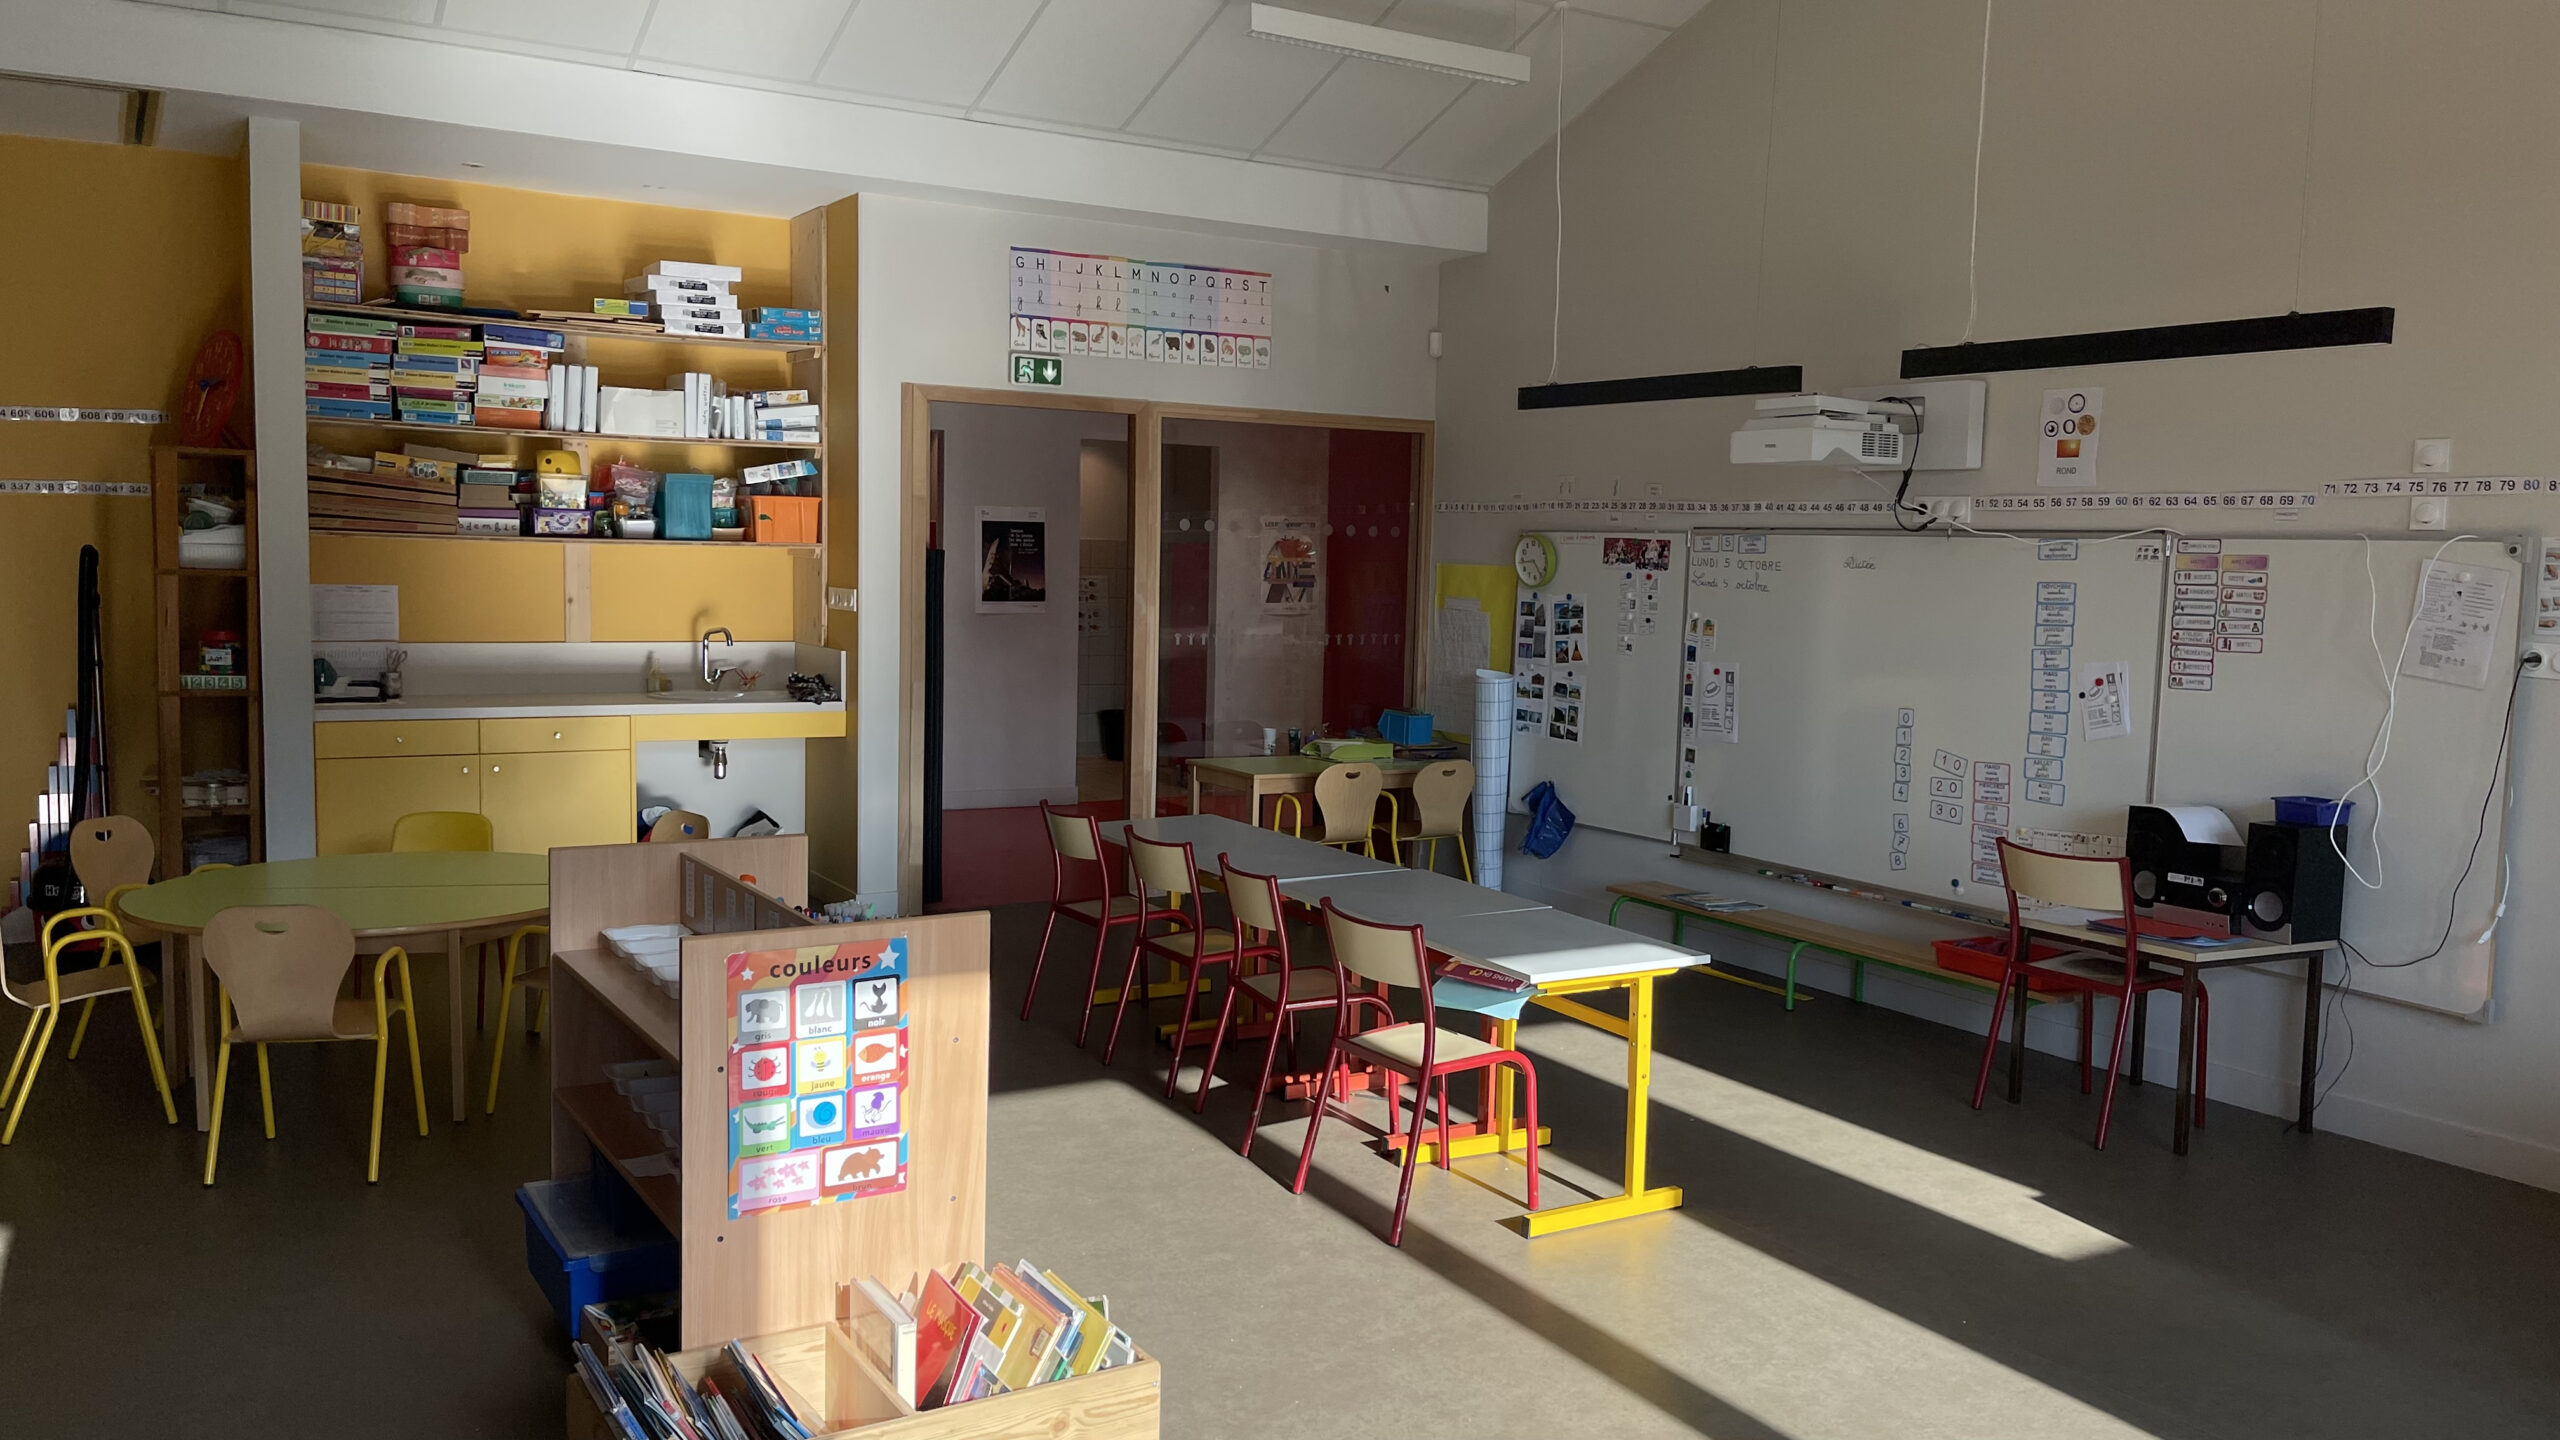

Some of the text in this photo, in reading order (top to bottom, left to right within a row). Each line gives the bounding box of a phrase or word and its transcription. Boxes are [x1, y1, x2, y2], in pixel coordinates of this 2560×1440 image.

[1016, 256, 1025, 268] G
[1036, 258, 1045, 270] H
[1076, 263, 1083, 275] J
[1096, 264, 1103, 276] K
[1114, 266, 1122, 278] L
[1132, 269, 1141, 280] M
[1152, 271, 1159, 283] N
[1169, 273, 1179, 284] O
[1189, 274, 1196, 286] P
[1206, 276, 1215, 288] Q
[1225, 278, 1232, 289] R
[1243, 279, 1249, 291] S
[1259, 281, 1267, 292] T
[34, 410, 55, 418] 606
[81, 411, 100, 420] 608
[2056, 467, 2076, 475] ROND
[10, 482, 29, 491] 337
[81, 484, 101, 492] 340
[129, 485, 149, 494] 342
[1639, 502, 1646, 510] 28
[1648, 502, 1656, 510] 29
[1754, 503, 1761, 511] 39
[1765, 503, 1773, 511] 40
[1776, 503, 1784, 511] 41
[1787, 503, 1795, 511] 42
[1798, 503, 1807, 511] 43
[1810, 503, 1820, 511] 44
[1823, 503, 1832, 511] 45
[1835, 503, 1844, 511] 46
[1847, 503, 1856, 511] 47
[1860, 503, 1869, 511] 48
[1872, 503, 1882, 512] 49
[1886, 503, 1896, 512] 50
[1975, 499, 1985, 508] 51
[1989, 499, 1999, 508] 52
[2002, 499, 2013, 508] 53
[2017, 499, 2028, 508] 54
[2033, 499, 2045, 508] 55
[2050, 498, 2062, 508] 56
[2066, 498, 2077, 507] 57
[2081, 497, 2093, 507] 58
[2098, 497, 2110, 506] 59
[2115, 496, 2128, 506] 60
[2132, 496, 2143, 506] 61
[2148, 496, 2161, 506] 62
[2166, 496, 2179, 506] 63
[2184, 496, 2197, 506] 64
[2203, 496, 2217, 506] 65
[2223, 496, 2236, 506] 66
[2240, 496, 2254, 506] 67
[2259, 495, 2273, 505] 68
[2279, 495, 2294, 506] 69
[2301, 495, 2315, 505] 70
[2324, 484, 2337, 494] 71
[2343, 484, 2357, 494] 72
[2364, 483, 2378, 493] 73
[2386, 482, 2401, 493] 74
[2409, 482, 2424, 492] 75
[2432, 482, 2447, 493] 76
[2454, 482, 2469, 492] 77
[2476, 481, 2492, 491] 78
[2499, 480, 2516, 491] 79
[2523, 479, 2540, 491] 80
[1725, 537, 1731, 547] 5
[1692, 557, 1782, 571] LUNDI 5 OCTOBRE
[1723, 580, 1729, 588] 5
[1736, 571, 1770, 592] octobre
[1903, 713, 1909, 723] 0
[1902, 731, 1906, 741] 1
[1900, 750, 1906, 760] 2
[1900, 767, 1906, 778] 3
[1898, 818, 1904, 829] 6
[1898, 837, 1905, 847] 7
[1895, 855, 1901, 866] 8
[770, 955, 871, 978] couleurs
[868, 1017, 886, 1027] noir
[808, 1026, 832, 1035] blanc
[755, 1032, 771, 1043] gris
[861, 1071, 891, 1083] orange
[811, 1080, 835, 1091] jaune
[862, 1128, 890, 1137] mauve
[812, 1135, 831, 1145] bleu
[755, 1143, 774, 1153] vert
[852, 1182, 872, 1192] brun
[768, 1195, 787, 1204] rose
[926, 1302, 958, 1341] LE MASQUE
